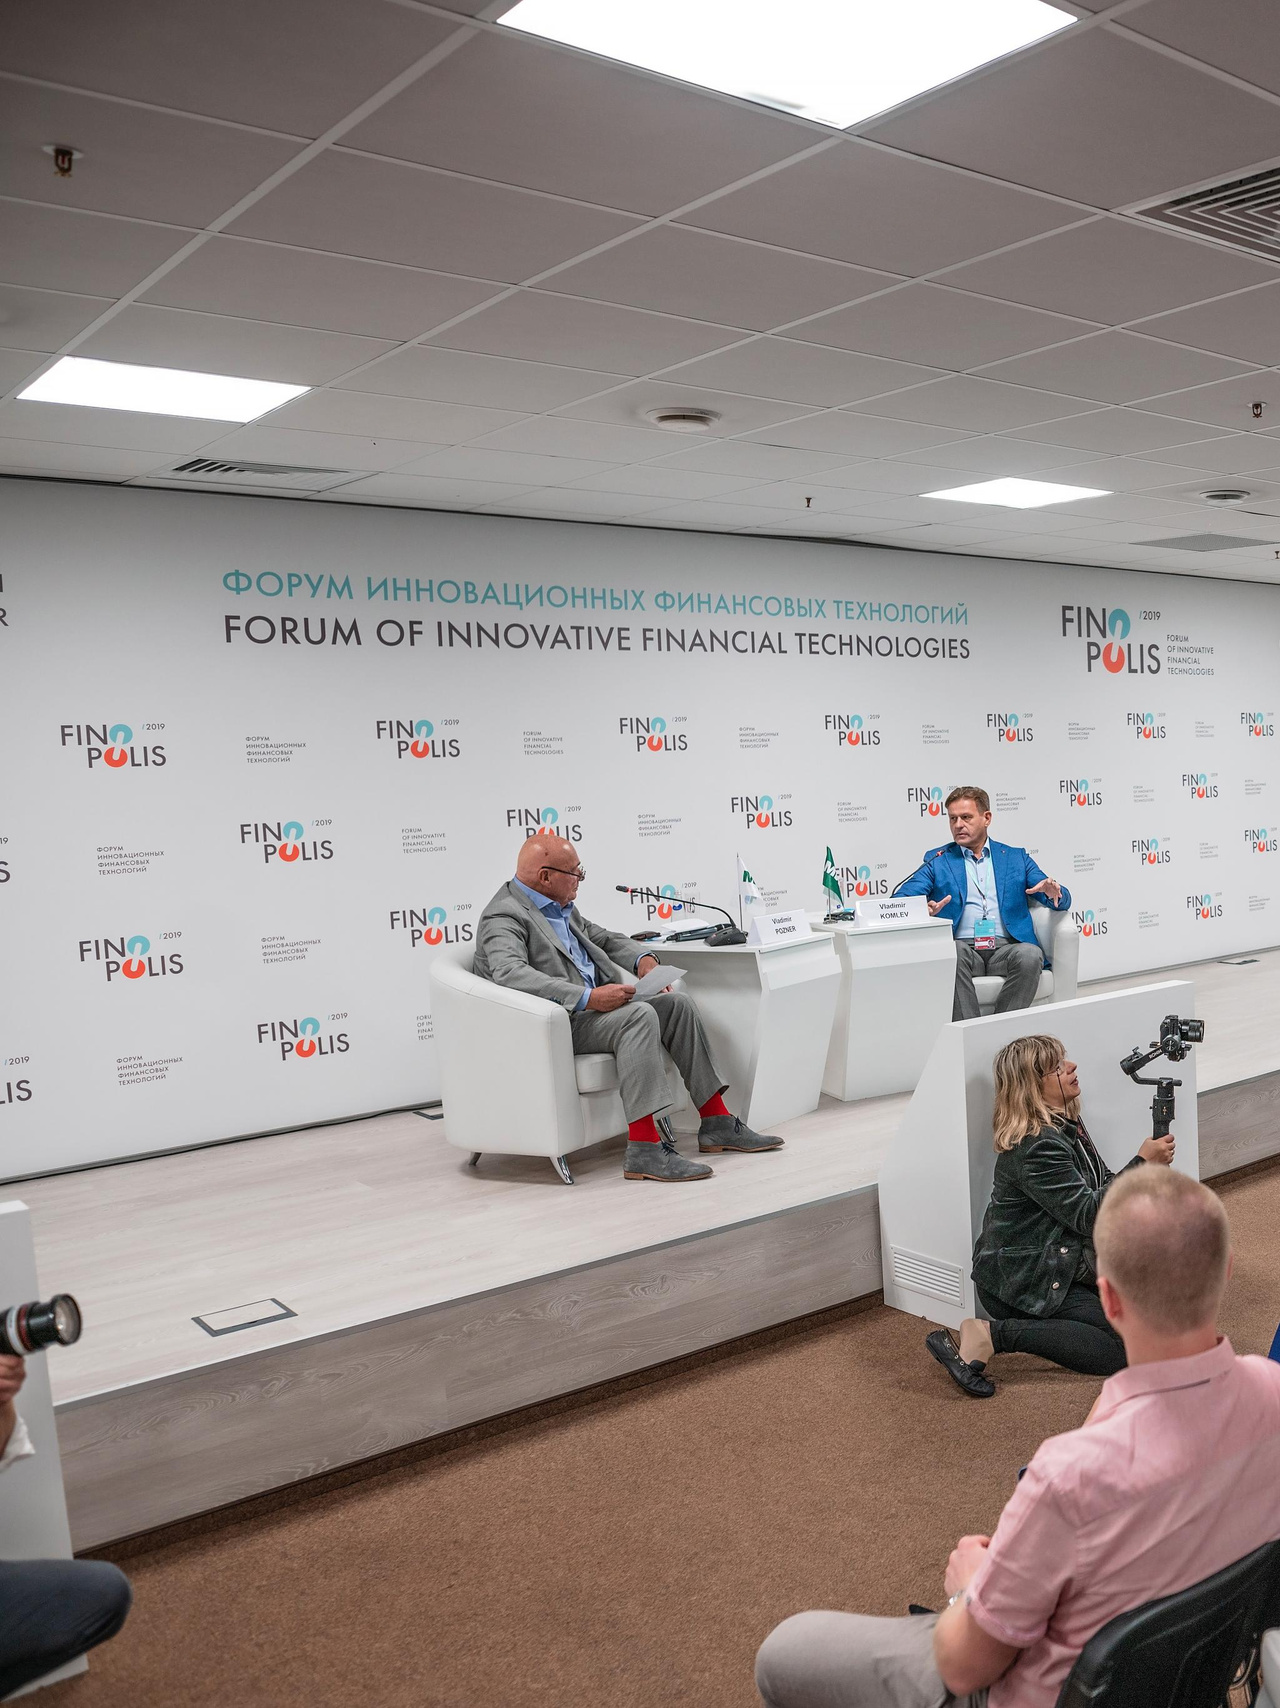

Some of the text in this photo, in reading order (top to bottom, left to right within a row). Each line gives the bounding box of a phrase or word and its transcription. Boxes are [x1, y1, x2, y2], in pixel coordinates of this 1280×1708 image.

[222, 569, 968, 625] ФОРУМ ИННОВАЦИОННЫХ ФИНАНСОВЫХ ТЕХНОЛОГИЙ
[1061, 605, 1131, 640] FINO
[225, 615, 970, 659] FORUM OF INNOVATIVE FINANCIAL TECHNOLOGIES
[1167, 634, 1189, 642] FORUM
[1167, 645, 1214, 654] OF INNOVATIVE
[1087, 641, 1161, 674] POLIS
[1167, 656, 1200, 665] FINANCIAL
[1167, 667, 1214, 676] TECHNOLOGIES
[619, 717, 666, 734] FINO
[825, 715, 863, 730] FINO
[987, 713, 1019, 728] FINO
[1127, 713, 1154, 726] FINO
[1241, 712, 1264, 724] FINO
[60, 724, 133, 746] FINO
[376, 720, 434, 739] FINO
[998, 728, 1033, 742] POLIS
[1137, 726, 1166, 739] POLIS
[1249, 724, 1274, 737] POLIS
[636, 734, 688, 752] POLIS
[839, 730, 881, 746] POLIS
[87, 745, 166, 768] POLIS
[397, 739, 460, 759] POLIS
[1060, 779, 1089, 793] FINO
[1182, 773, 1207, 787] FINO
[908, 787, 942, 802] FINO
[1070, 792, 1102, 807] POLIS
[1191, 785, 1218, 799] POLIS
[731, 796, 773, 813] FINO
[506, 807, 559, 827] FINO
[746, 811, 792, 829] POLIS
[240, 821, 304, 844] FINO
[1244, 828, 1267, 842] FINO
[264, 840, 333, 864] POLIS
[1132, 839, 1158, 853] FINO
[1252, 839, 1278, 853] POLIS
[97, 851, 164, 860] ИННОВАЦИОННЫХ
[98, 859, 150, 867] ФИНАНСОВЫХ
[1141, 850, 1171, 865] POLIS
[98, 866, 147, 875] ТЕХНОЛОГИЙ
[846, 879, 888, 898] POLIS
[1187, 894, 1211, 908] FINO
[390, 907, 447, 930] FINO
[880, 911, 909, 919] KOMLEV
[1071, 909, 1095, 925] INO
[1195, 904, 1223, 920] POLIS
[411, 923, 473, 947] POLIS
[775, 925, 797, 935] POZNER
[79, 935, 150, 962] FINO
[261, 939, 321, 950] ИННОВАЦИОННЫХ
[262, 948, 308, 957] ФИНАНСОВЫХ
[263, 953, 306, 964] ТЕХНОЛОГИЙ
[105, 954, 184, 982] POLIS
[257, 1017, 320, 1043] FINO
[281, 1033, 350, 1061] POLIS
[116, 1056, 143, 1064] ФОРУМ
[117, 1057, 183, 1071] ИННОВАЦИОННЫХ
[118, 1066, 169, 1078] ФИНАНСОВЫХ
[118, 1073, 166, 1086] ТЕХНОЛОГИЙ
